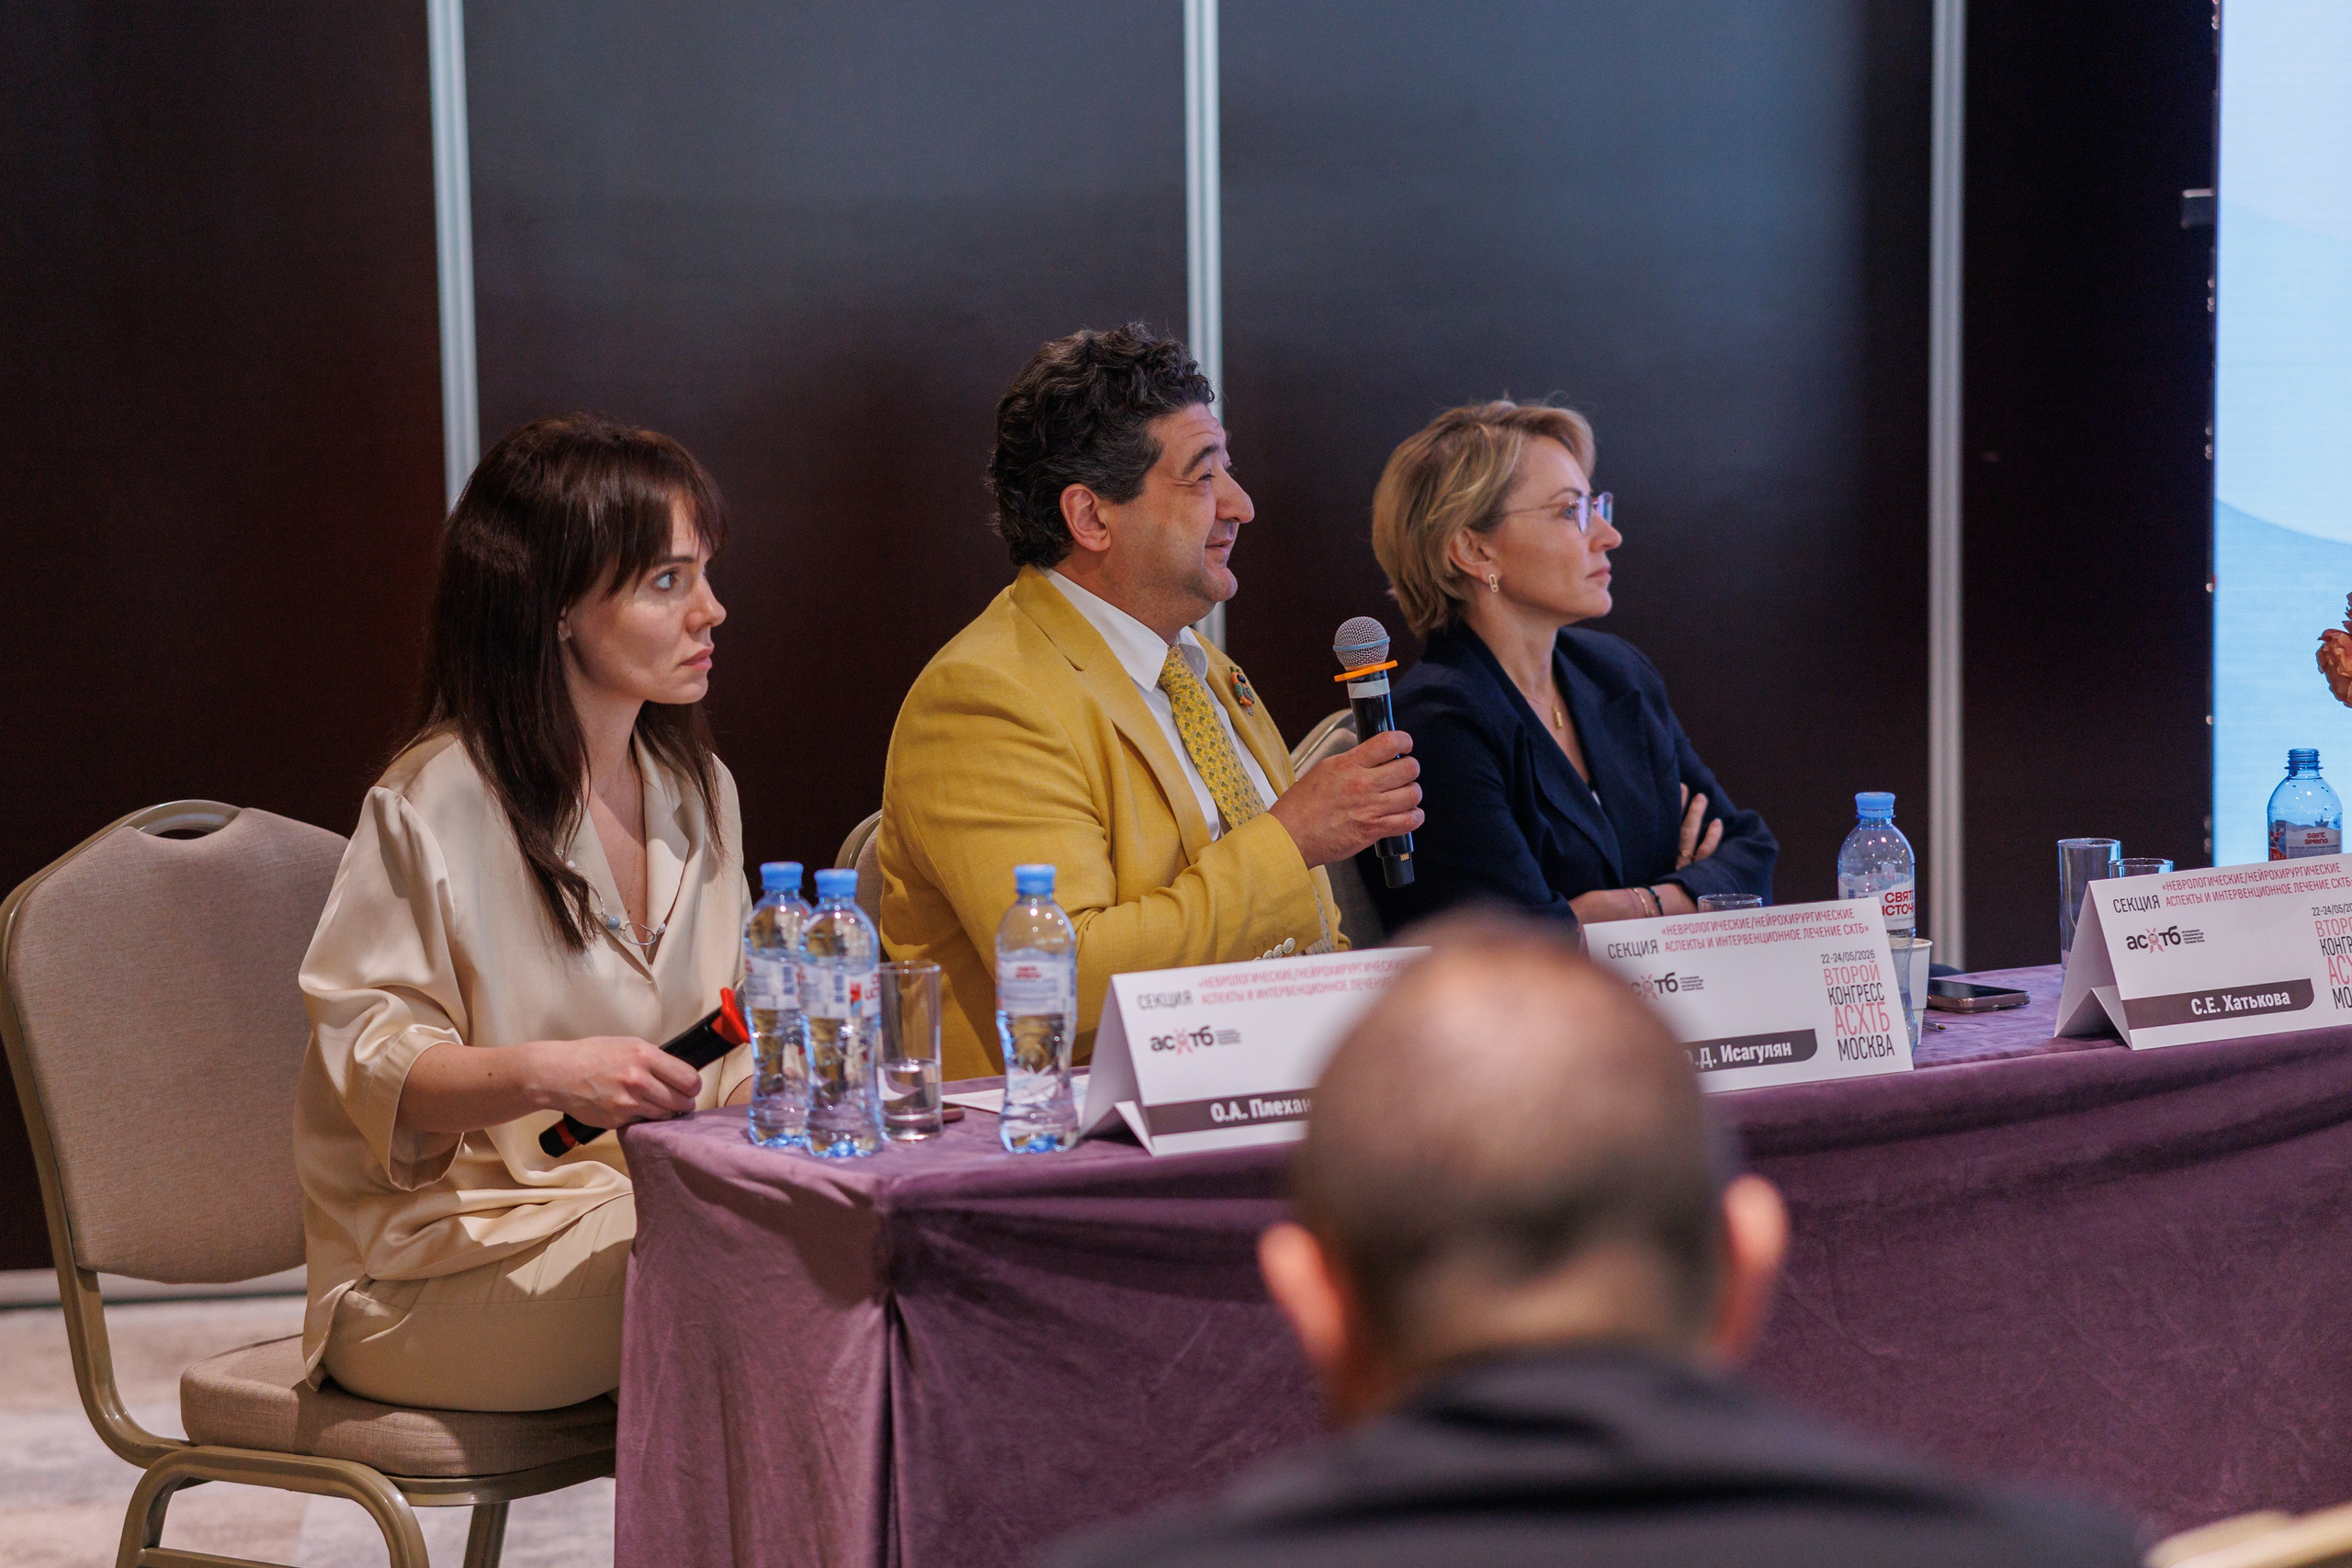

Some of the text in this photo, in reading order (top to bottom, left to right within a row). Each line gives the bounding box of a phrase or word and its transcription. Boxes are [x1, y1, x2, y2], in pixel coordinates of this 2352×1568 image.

[2162, 863, 2342, 891] «НЕВРОЛОГИЧЕСКИЕ/НЕЙРОХИРУРГИЧЕСКИЕ
[2113, 895, 2161, 913] СЕКЦИЯ
[2165, 893, 2203, 907] АСПЕКТЫ
[2204, 892, 2211, 902] И
[2212, 886, 2292, 902] ИНТЕРВЕНЦИОННОЕ
[2294, 879, 2330, 893] ЛЕЧЕНИЕ
[1662, 908, 1855, 936] «НЕВРОЛОГИЧЕСКИЕ/НЕЙРОХИРУРГИЧЕСКИЕ
[1608, 939, 1658, 959] СЕКЦИЯ
[1665, 923, 1869, 953] АСПЕКТЫ И ИНТЕРВЕНЦИОННОЕ ЛЕЧЕНИЕ СХТБ»
[1824, 960, 1881, 986] ВТОРОЙ
[1137, 990, 1193, 1010] СЕКЦИЯ
[1201, 990, 1244, 1005] АСПЕКТЫ
[1247, 989, 1255, 1000] И
[1827, 982, 1884, 1006] КОНГРЕСС
[2191, 992, 2291, 1015] С.Е. Хатькова
[1835, 1001, 1890, 1036] АСХТБ
[1720, 1042, 1792, 1064] Исагулян
[1838, 1034, 1895, 1061] МОСКВА
[1210, 1100, 1249, 1122] О.А.
